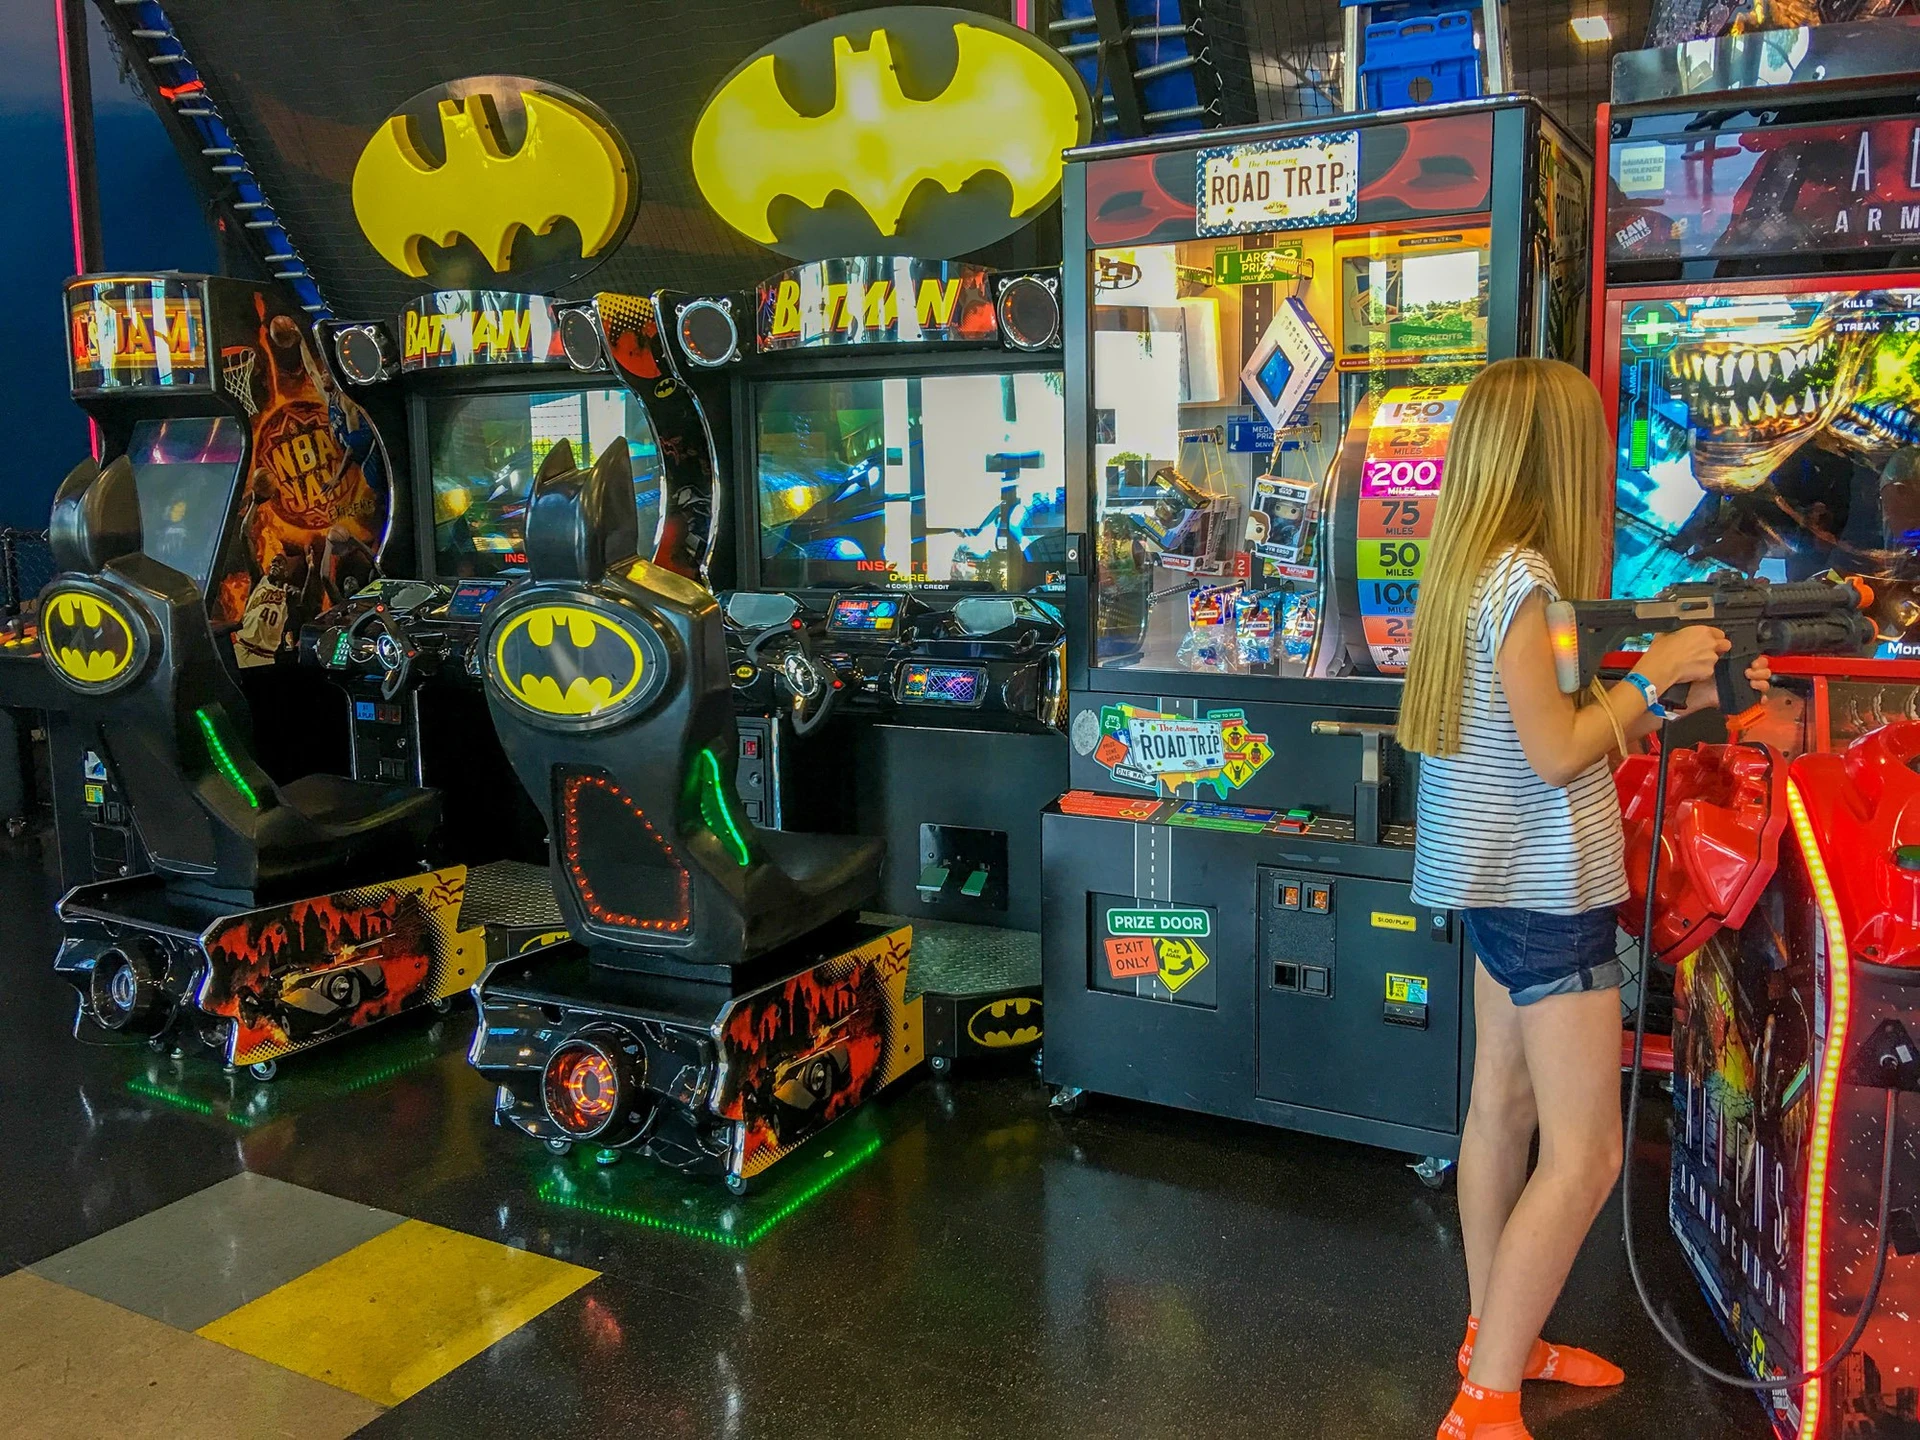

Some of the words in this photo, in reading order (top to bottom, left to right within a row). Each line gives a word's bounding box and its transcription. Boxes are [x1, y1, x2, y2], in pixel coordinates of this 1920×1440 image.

[1622, 157, 1664, 166] ANIMATED
[1623, 165, 1662, 175] VIOLENCE
[1211, 170, 1271, 206] ROAD
[1283, 162, 1345, 198] TRIP
[1632, 175, 1653, 183] MILD
[1615, 216, 1648, 243] RAW
[1620, 226, 1652, 249] THRILLS
[1240, 252, 1268, 264] LARG
[1241, 262, 1270, 273] PRIZ
[1843, 298, 1874, 309] KILLS
[1835, 322, 1880, 332] STREAK
[404, 309, 531, 361] BATAN
[1628, 365, 1638, 395] AMMO
[1410, 386, 1448, 397] 75
[1392, 402, 1446, 418] 150
[1390, 427, 1431, 447] 25
[272, 428, 338, 481] NBA
[1393, 447, 1423, 456] MILES
[1371, 461, 1437, 486] 200
[1387, 486, 1417, 496] MILES
[1381, 500, 1421, 527] 75
[1385, 527, 1415, 535] MILES
[504, 553, 529, 563] INS
[1379, 542, 1421, 567] 50
[1237, 559, 1246, 571] 2
[1385, 568, 1415, 577] MILES
[259, 606, 279, 627] 40
[1157, 723, 1173, 732] The
[1175, 725, 1200, 733] Amazing
[1140, 734, 1187, 761] ROAD
[1189, 734, 1221, 757] TRIP
[1117, 768, 1131, 777] ONE
[1132, 771, 1146, 780] WAY
[1114, 915, 1156, 929] PRIZE
[1160, 916, 1204, 930] DOOR
[1115, 940, 1144, 954] EXIT
[1165, 952, 1182, 960] AGAIN
[1116, 956, 1150, 971] ONLY
[1685, 1071, 1784, 1255] ALIENS
[1680, 1163, 1787, 1326] ARMAGEDDON
